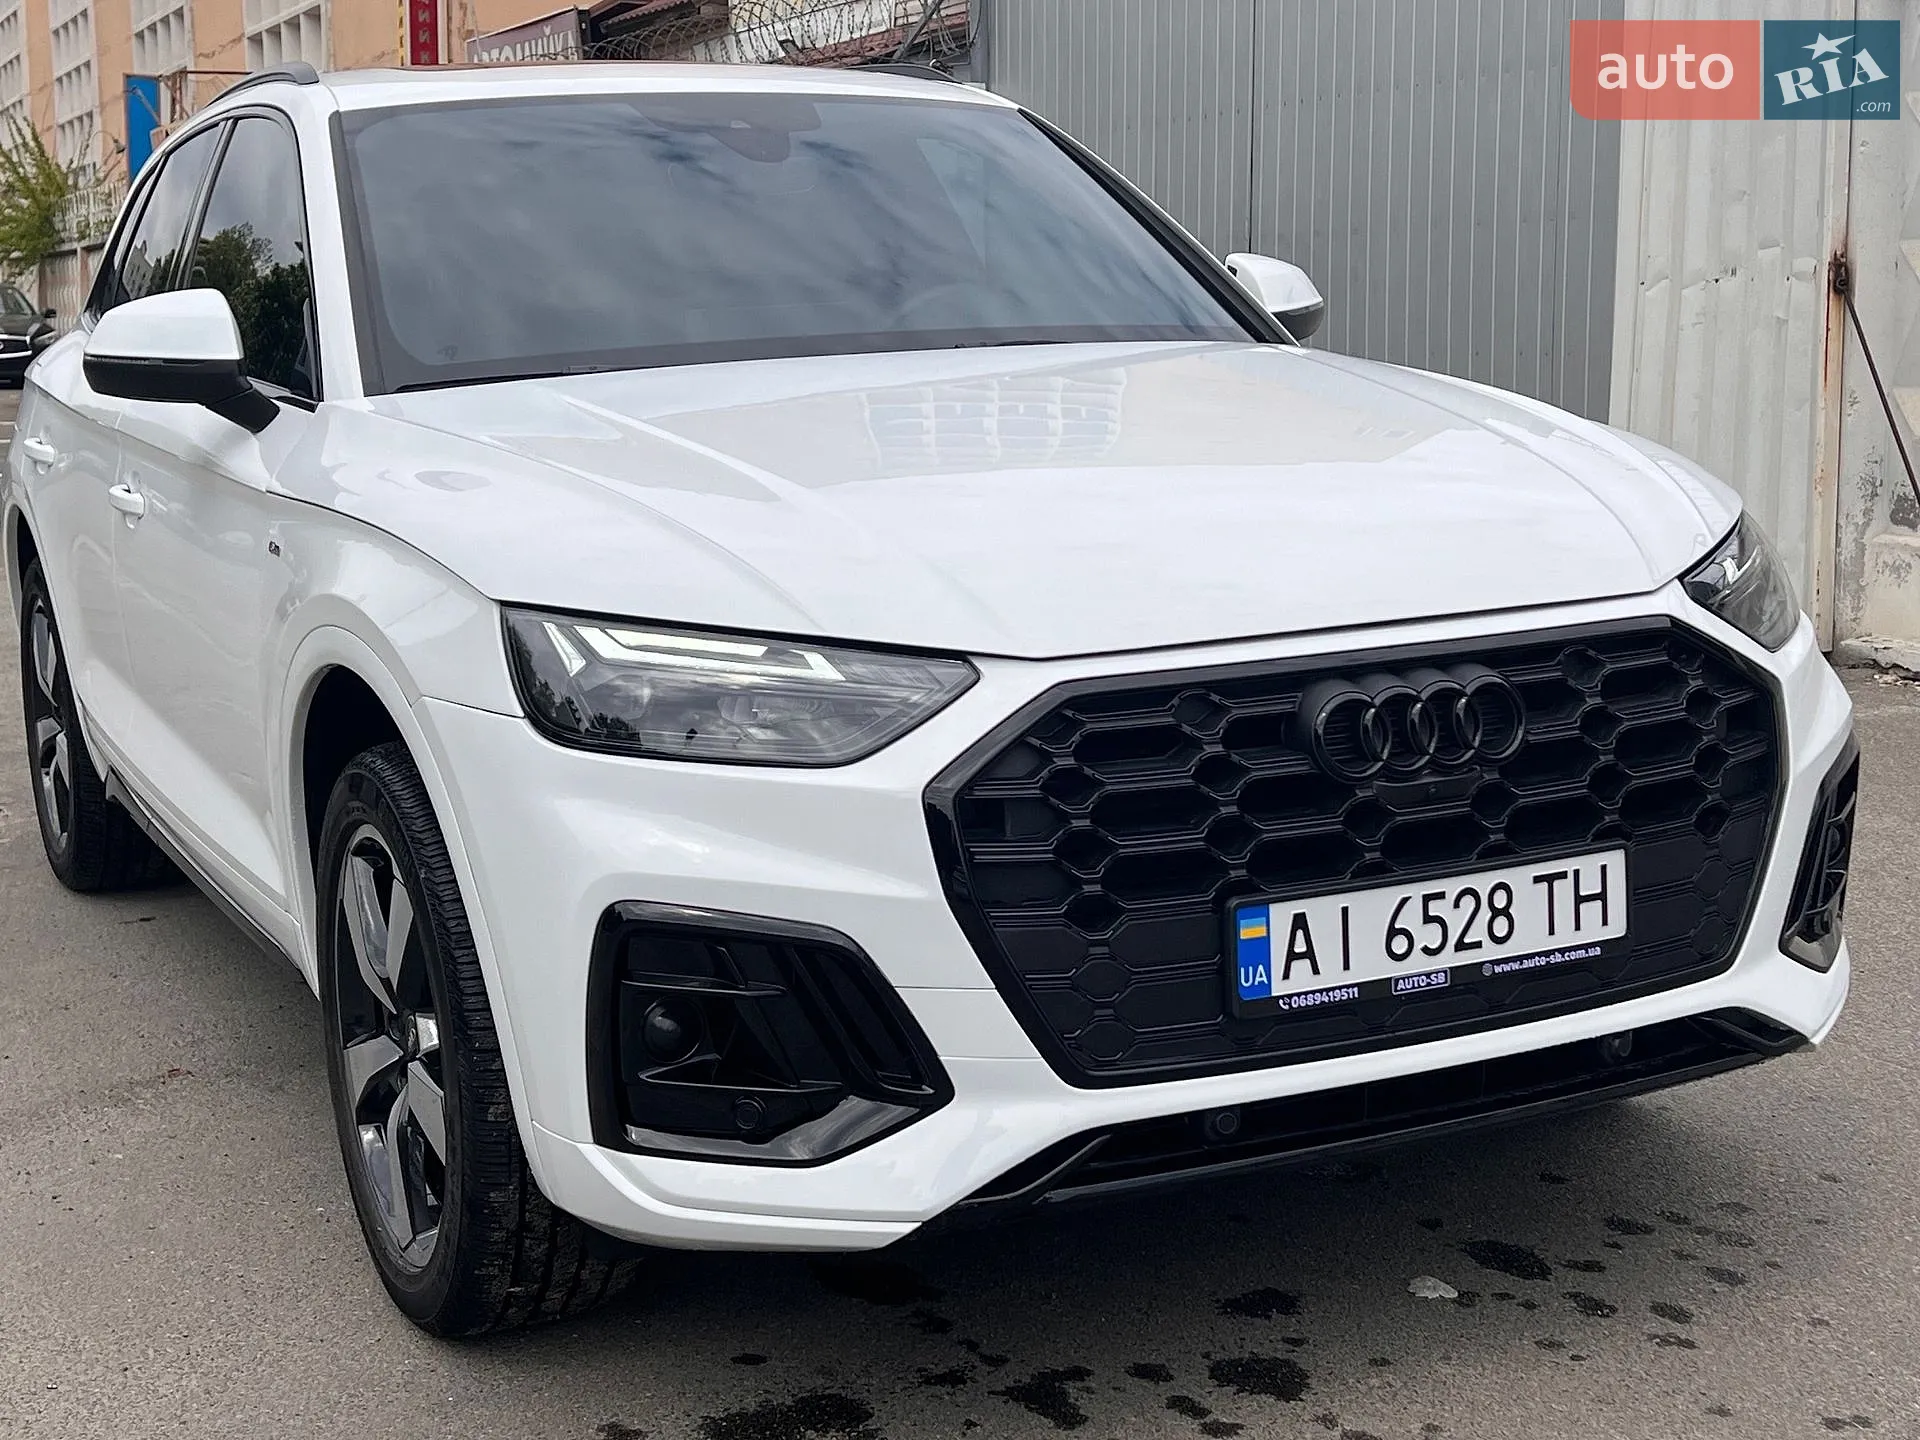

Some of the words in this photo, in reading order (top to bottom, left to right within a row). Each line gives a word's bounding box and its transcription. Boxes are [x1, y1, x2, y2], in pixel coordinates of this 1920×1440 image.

[1281, 906, 1351, 981] AI
[1384, 881, 1516, 963] 6528
[1533, 863, 1609, 937] TH
[1493, 946, 1601, 974] www.auto-sb.com.ua
[1240, 964, 1268, 988] UA
[1396, 972, 1446, 991] AUTO-SB
[1290, 987, 1359, 1009] 0689419511
